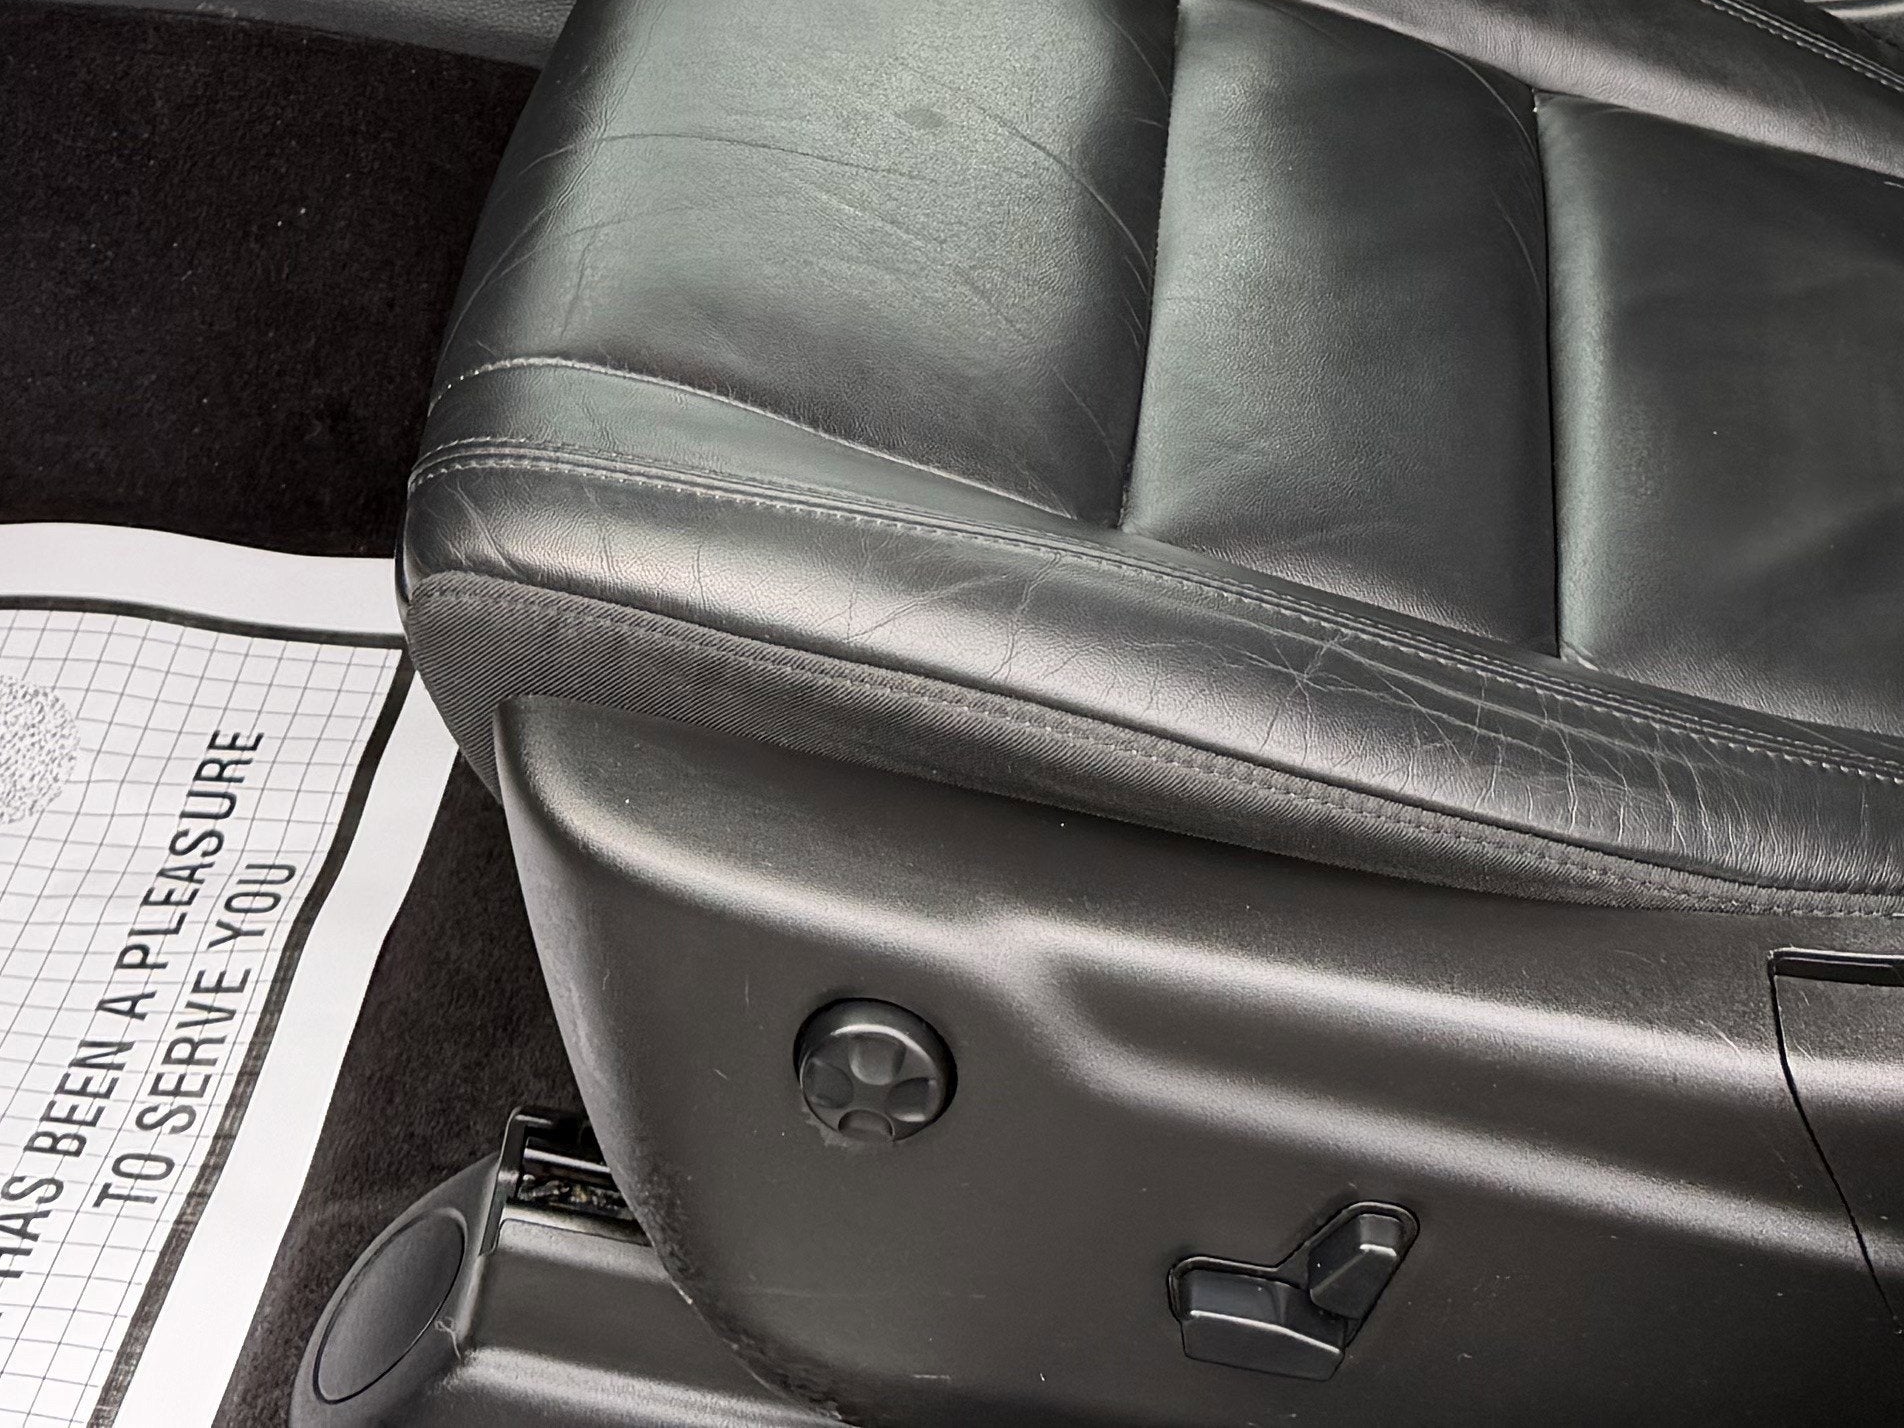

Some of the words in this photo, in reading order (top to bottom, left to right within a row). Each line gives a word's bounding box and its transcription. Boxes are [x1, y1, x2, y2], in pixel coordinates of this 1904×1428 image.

[115, 727, 266, 971] PLEASURE
[92, 1151, 175, 1209] TO
[135, 968, 251, 1135] SERVE
[209, 861, 298, 953] YOU
[96, 989, 157, 1019] A
[23, 1038, 136, 1159] BEEN
